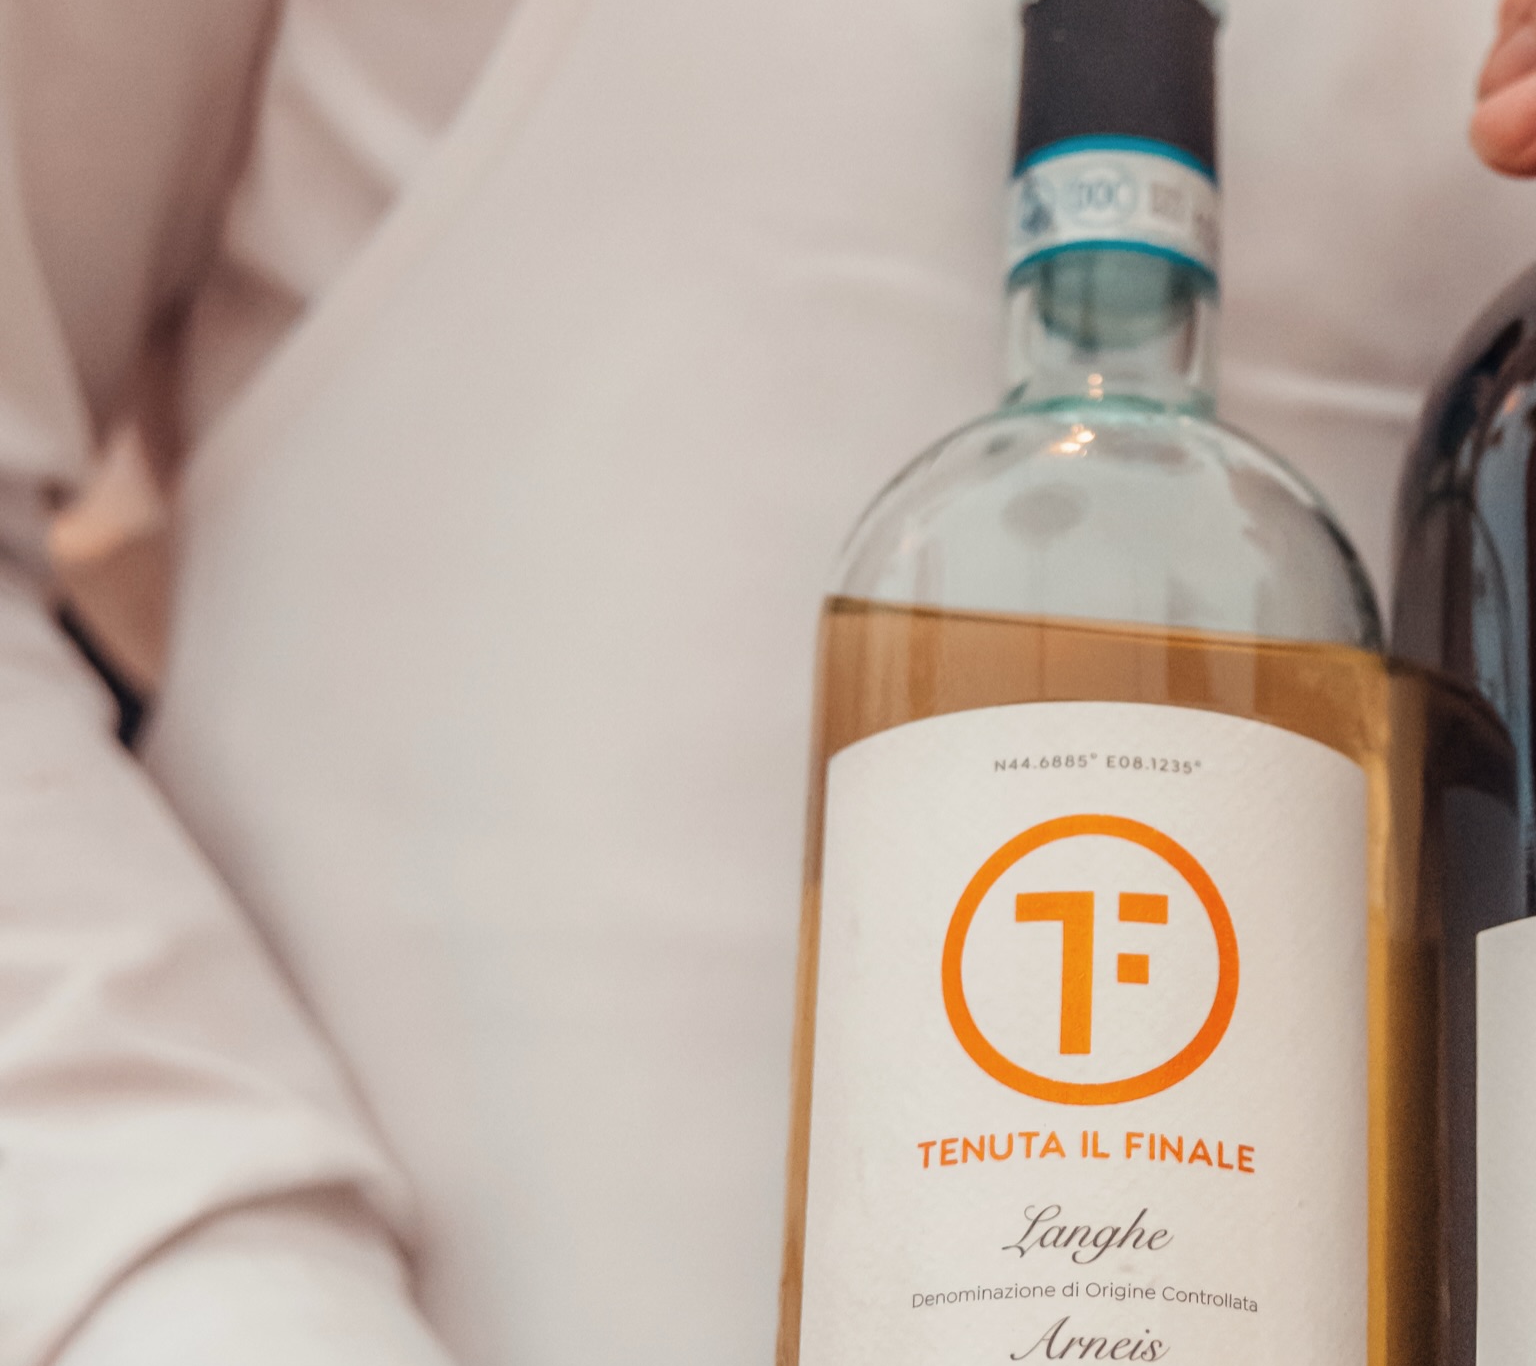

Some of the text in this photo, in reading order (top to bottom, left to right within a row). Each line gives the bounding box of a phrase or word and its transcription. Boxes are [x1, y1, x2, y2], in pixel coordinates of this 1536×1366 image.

[994, 753, 1097, 771] N44.6885°
[917, 1131, 1255, 1174] TENUTA IL FINALE
[1002, 1205, 1172, 1264] Langhe
[912, 1282, 1258, 1313] Denominazione di Origine Controllata
[1010, 1316, 1169, 1363] Arneis
